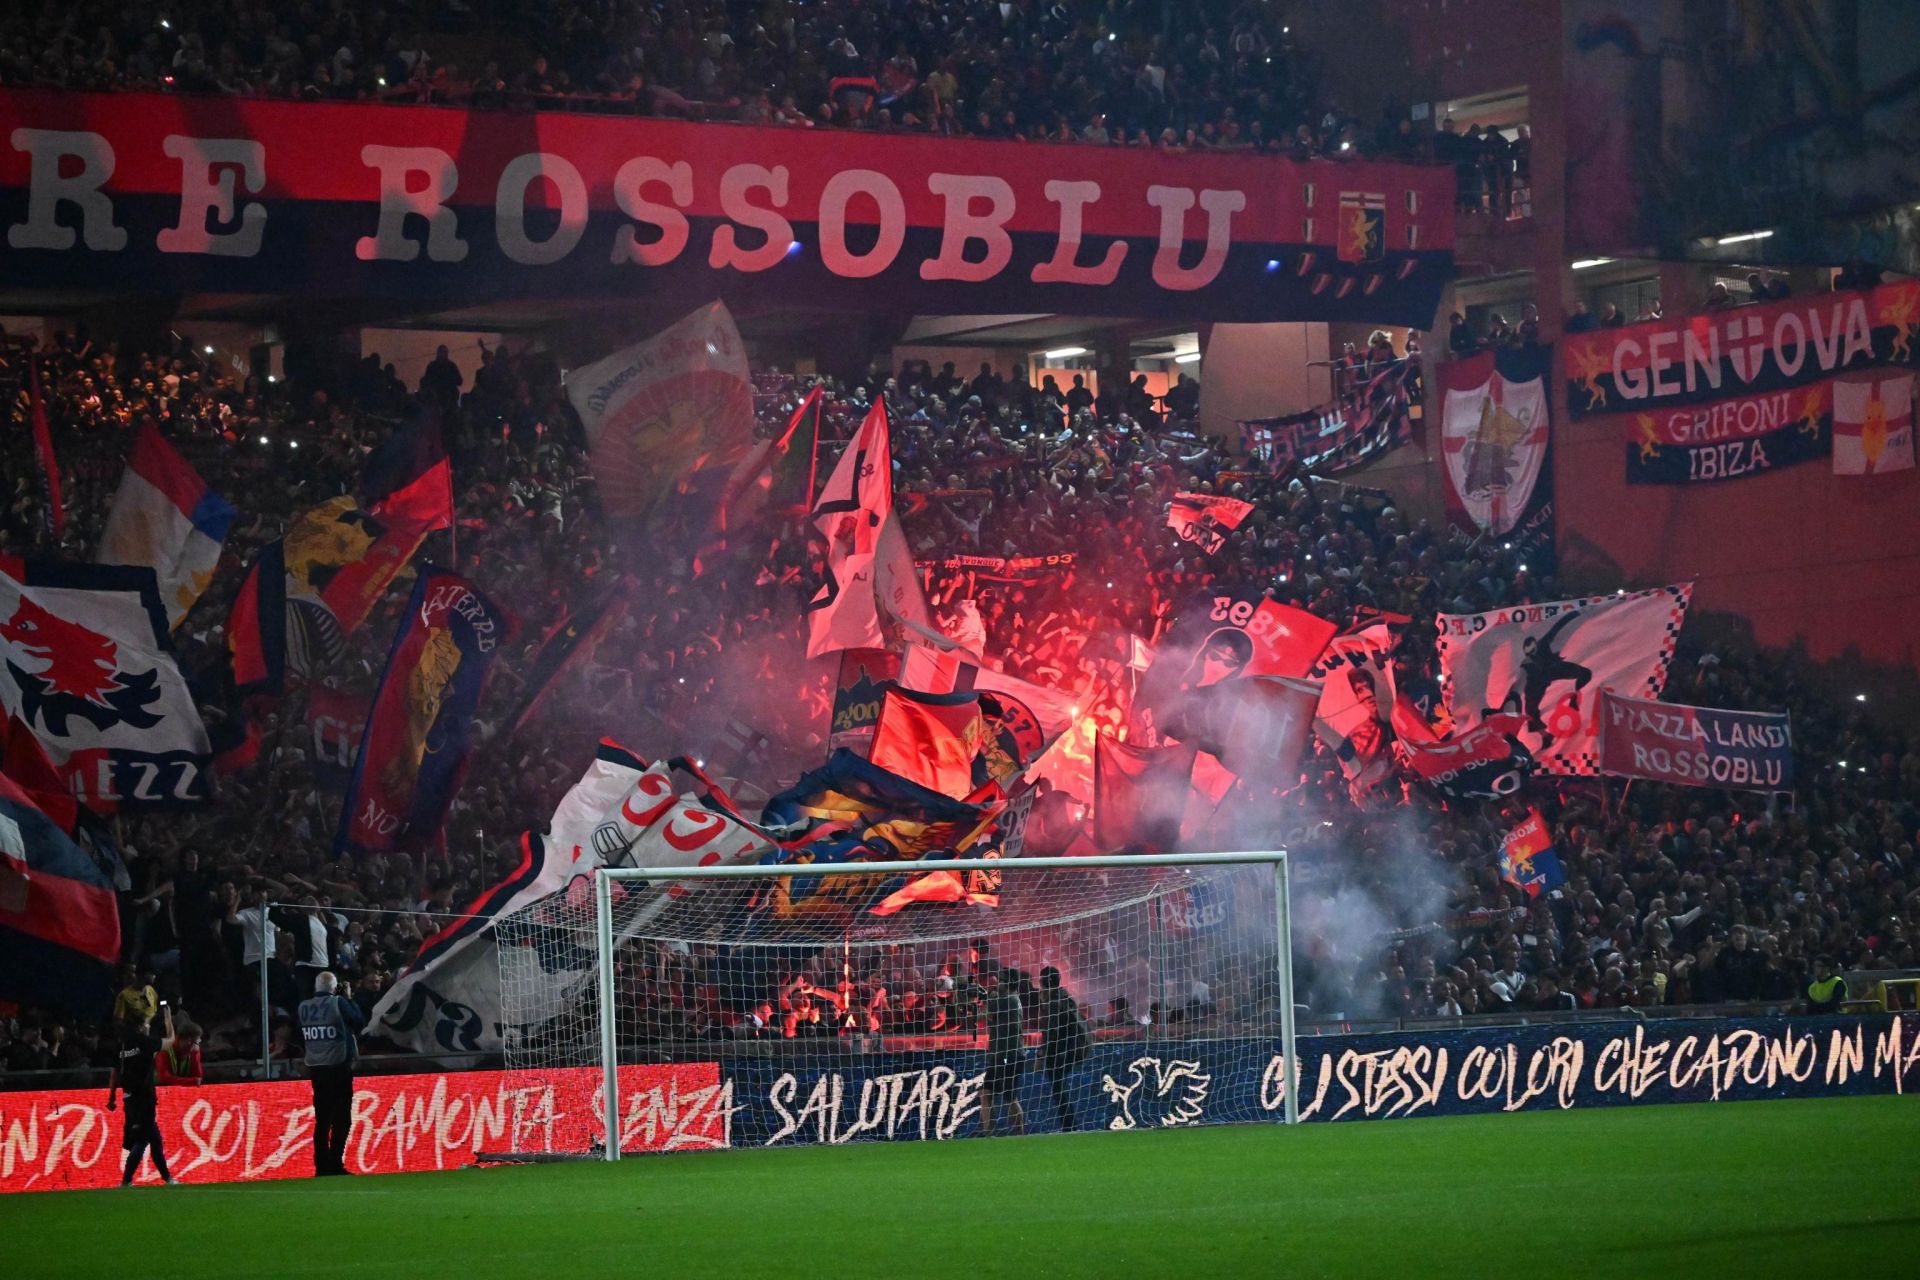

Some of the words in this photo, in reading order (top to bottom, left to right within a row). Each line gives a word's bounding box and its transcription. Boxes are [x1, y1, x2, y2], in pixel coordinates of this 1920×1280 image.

[8, 127, 268, 257] RE
[356, 144, 1247, 291] ROSSOBLU
[1668, 393, 1791, 443] GRIFONI
[1688, 440, 1771, 480] IBIZA
[1609, 701, 1711, 743] PIAZZA
[1632, 742, 1782, 785] ROSSOBLU
[0, 1099, 109, 1185] NDO
[172, 1097, 316, 1182] SOLE
[342, 1075, 565, 1173] RAMONTA
[768, 1065, 985, 1147] SALUTARE
[1331, 1044, 1447, 1119] STESSI
[1458, 1035, 1584, 1113] COLORI
[1595, 1024, 1669, 1098] CHE
[1670, 1023, 1817, 1101] CADONO
[1824, 1022, 1864, 1086] IN
